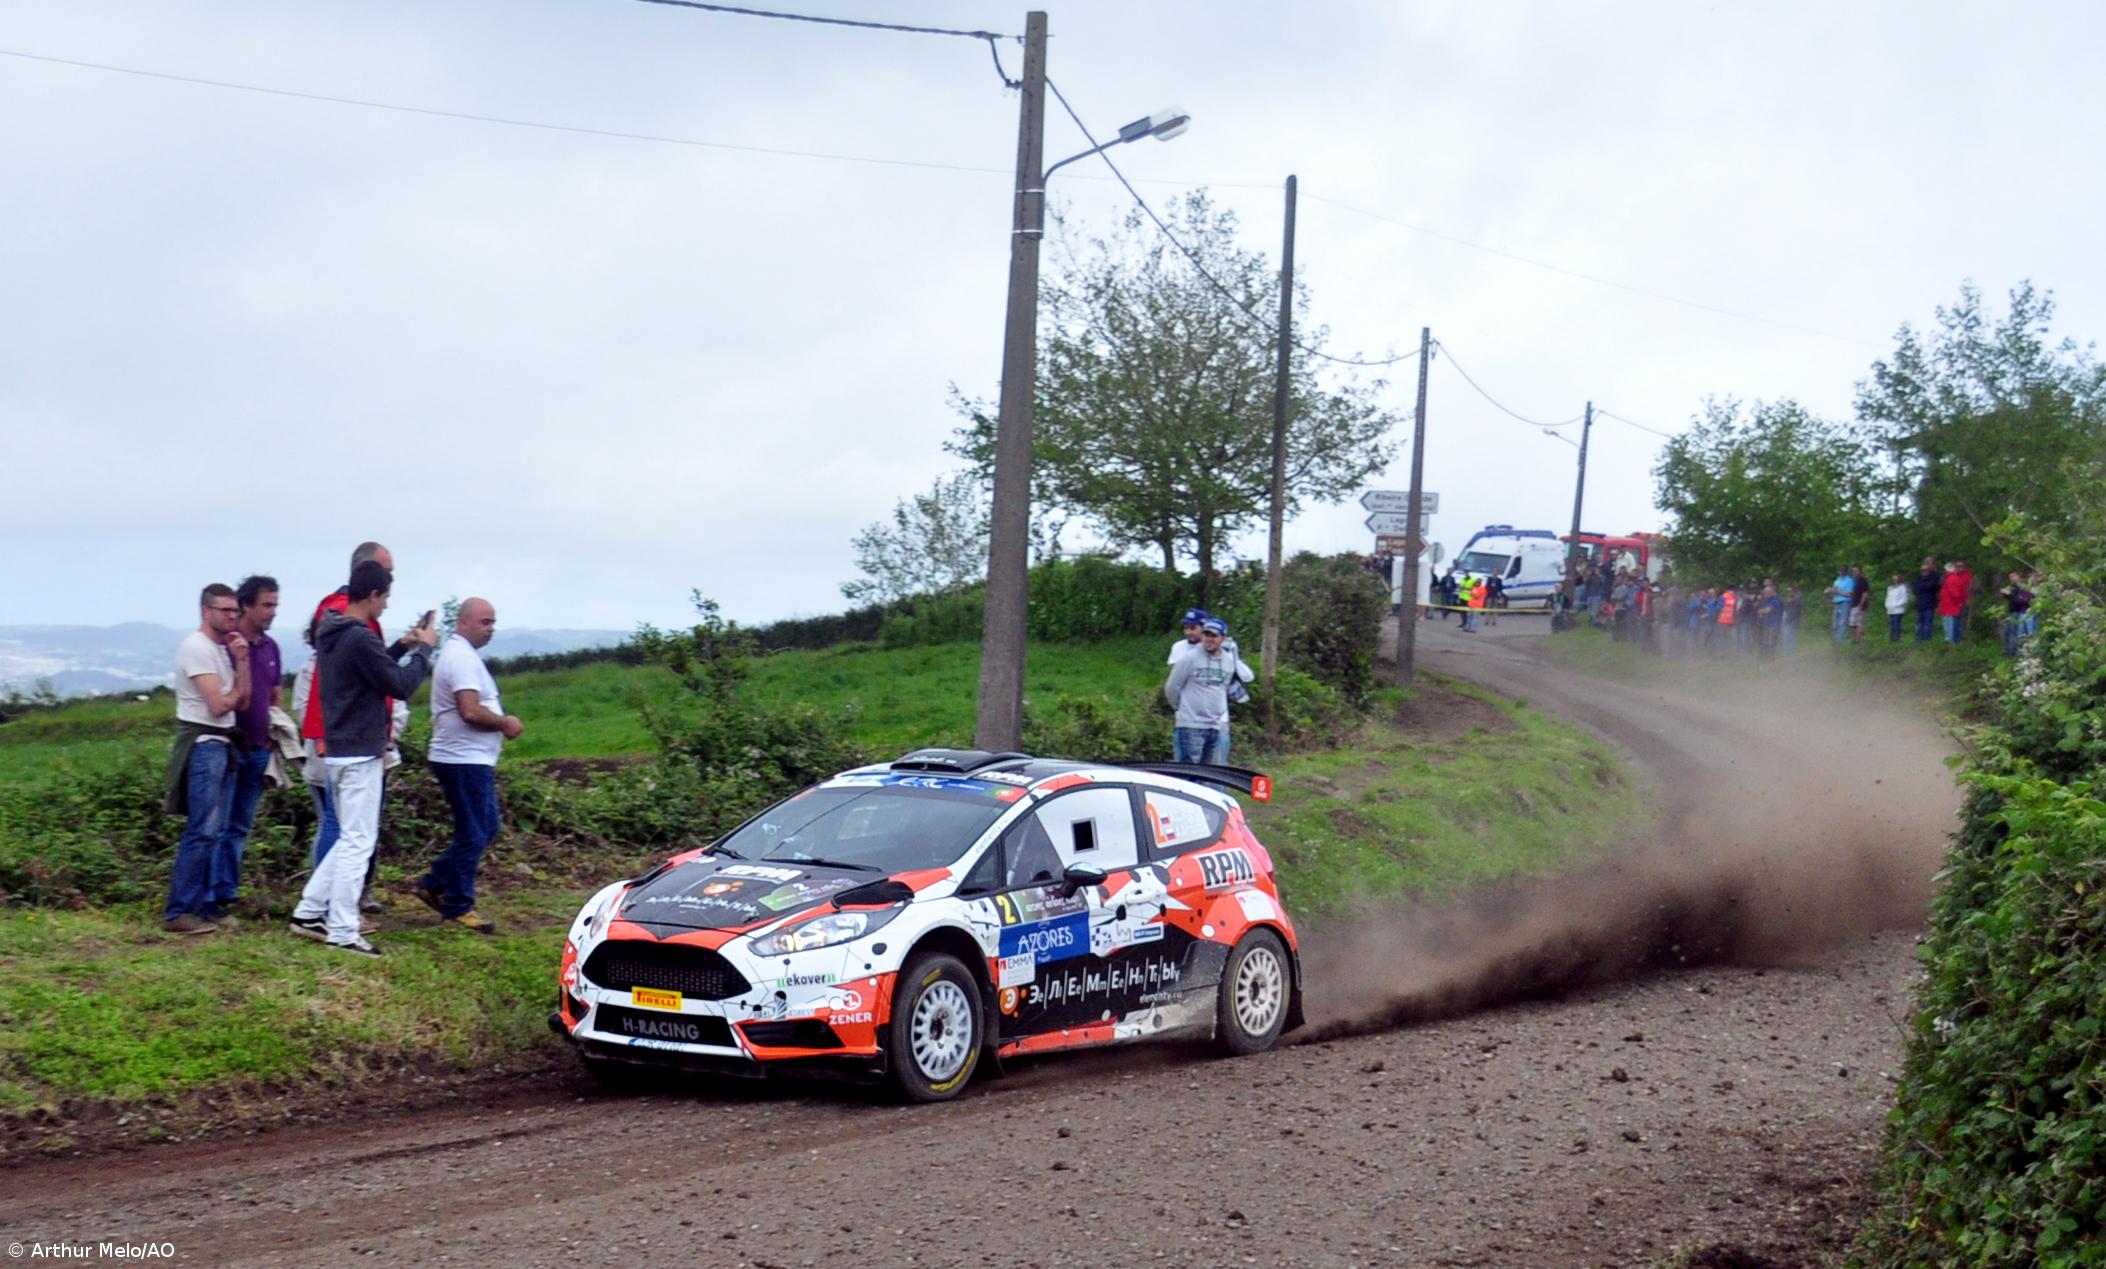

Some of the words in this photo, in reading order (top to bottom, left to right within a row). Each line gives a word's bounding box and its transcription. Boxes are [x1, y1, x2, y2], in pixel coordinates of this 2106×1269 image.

[1198, 850, 1253, 887] RPM
[996, 895, 1016, 925] 2
[1017, 925, 1074, 955] AZORES
[787, 973, 827, 986] ekover
[637, 991, 677, 1007] PIRELLI
[622, 1016, 700, 1040] H-RACING
[828, 1012, 873, 1025] ZENER
